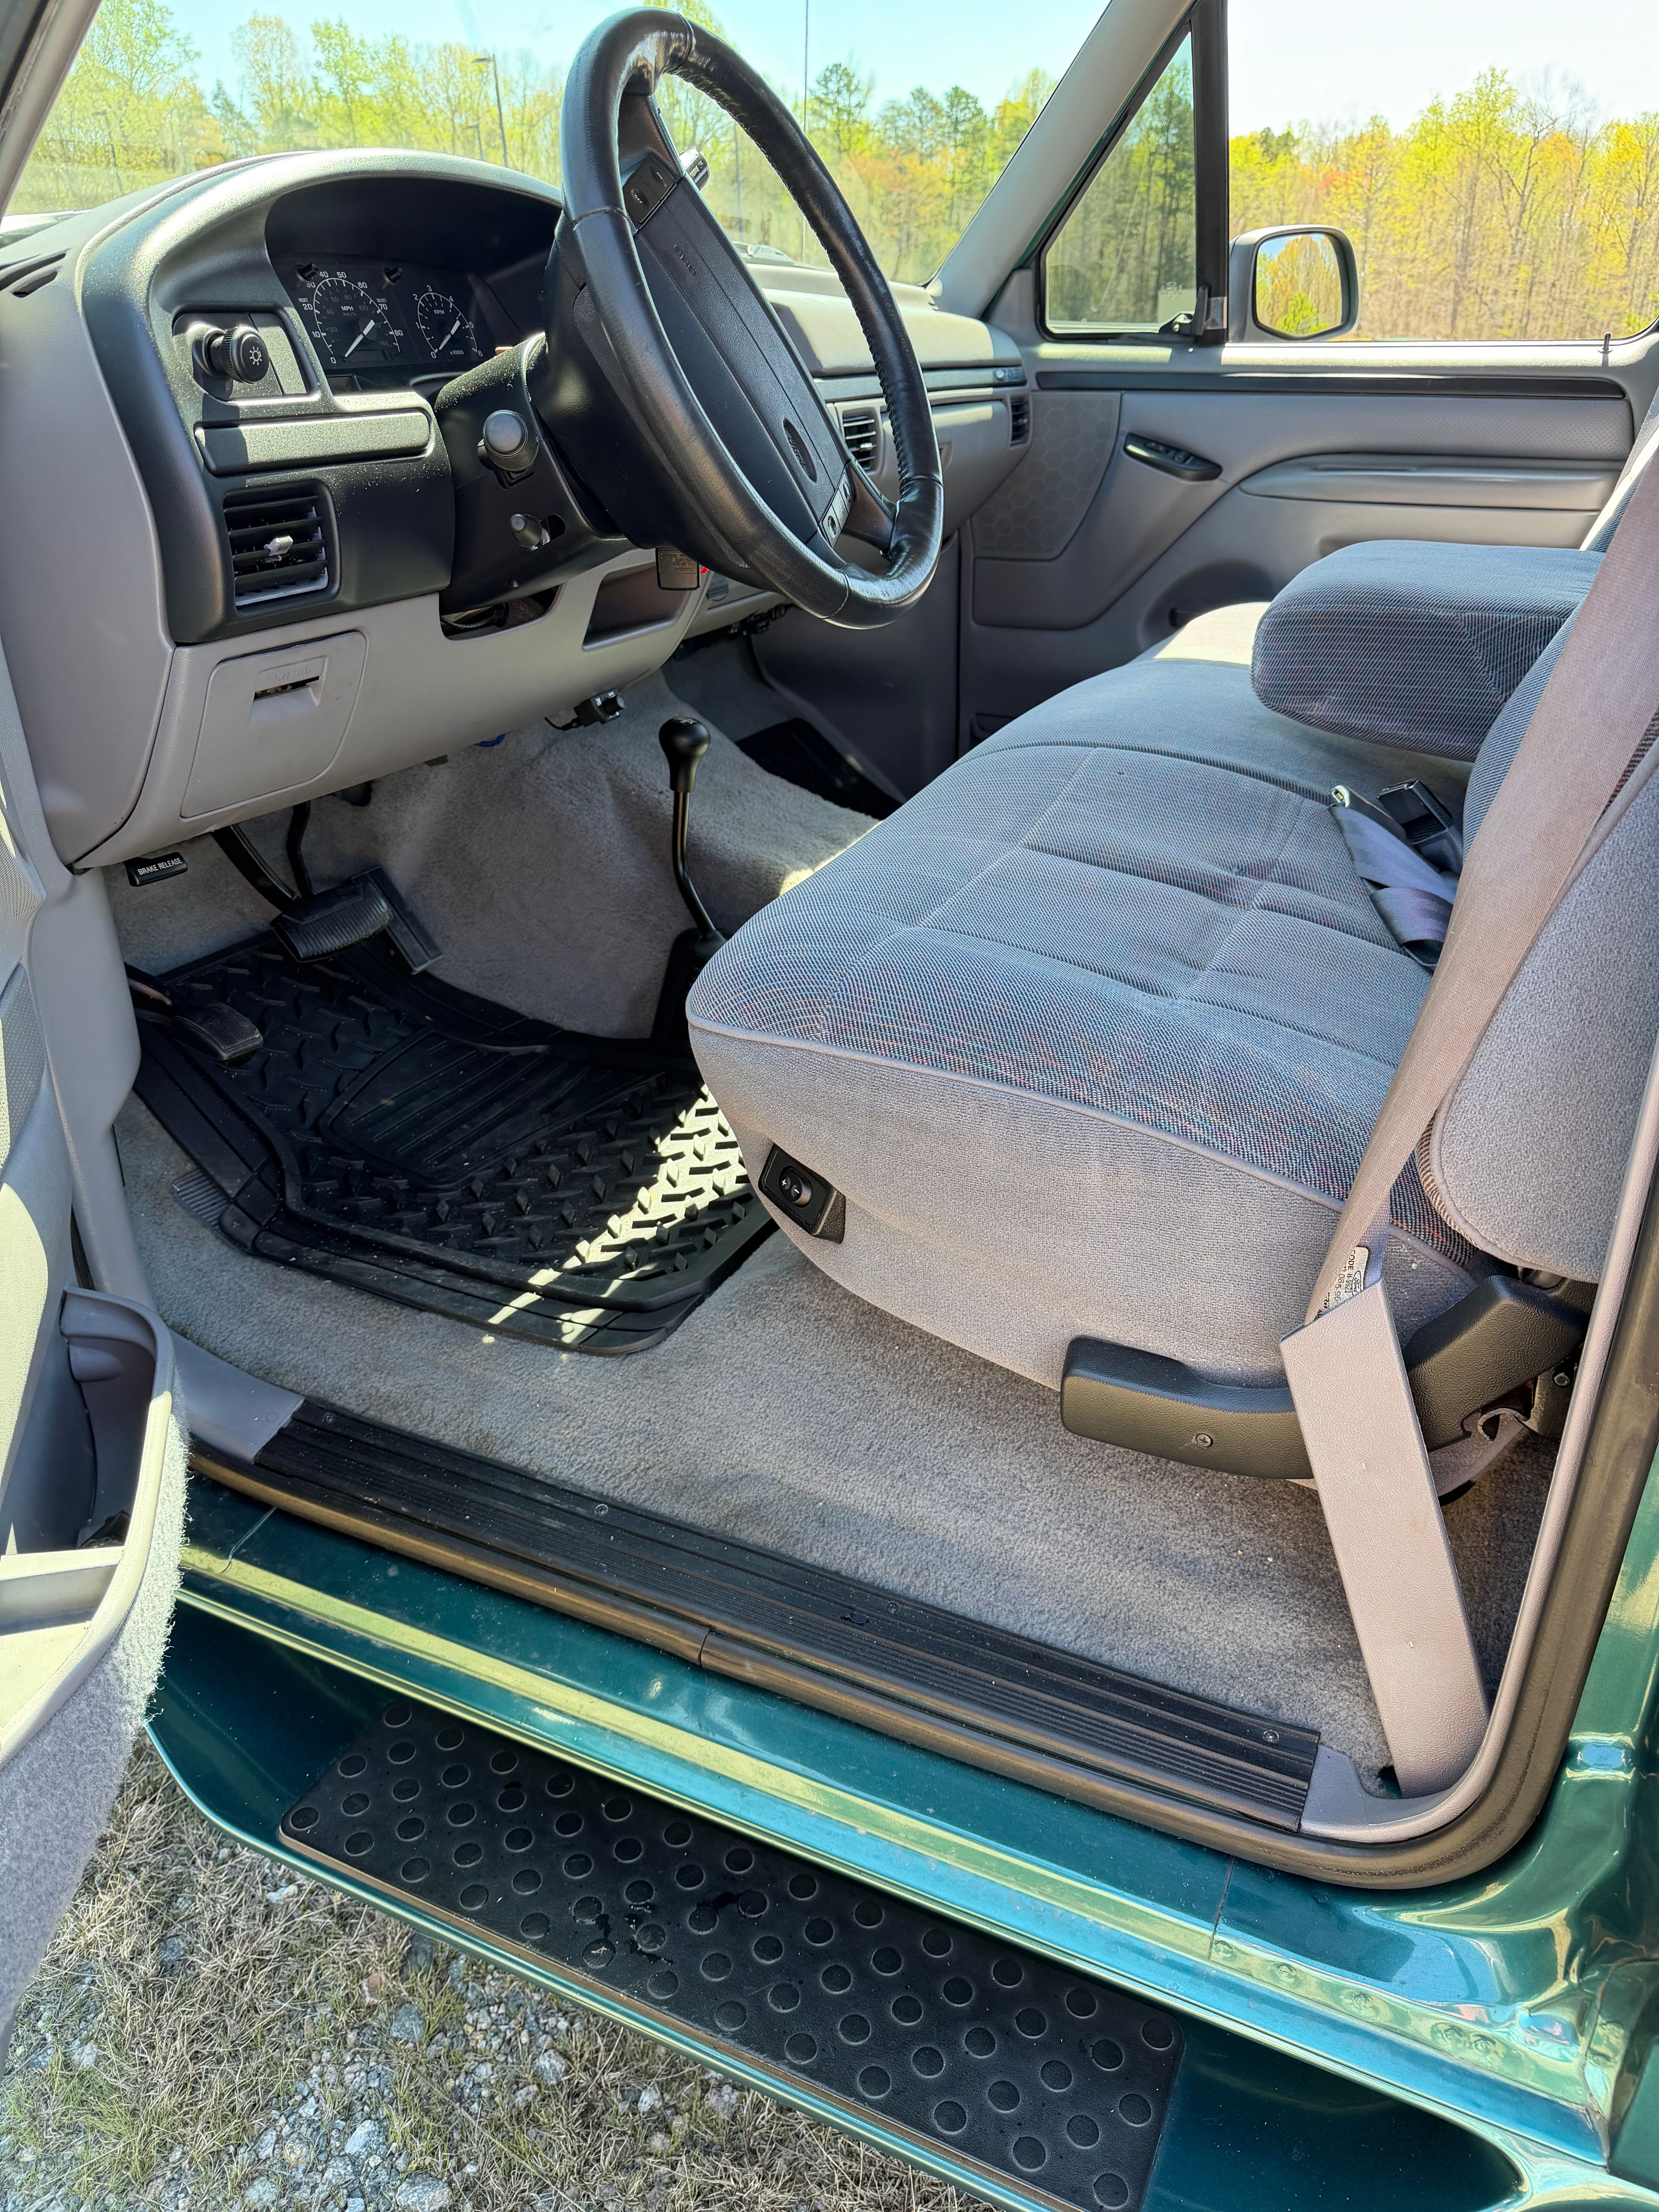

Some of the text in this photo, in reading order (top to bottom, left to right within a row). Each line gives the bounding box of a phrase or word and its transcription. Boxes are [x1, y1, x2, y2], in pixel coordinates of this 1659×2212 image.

[634, 194, 643, 204] OFF
[788, 436, 805, 469] Ford
[137, 857, 183, 876] BRAKE RELEASE
